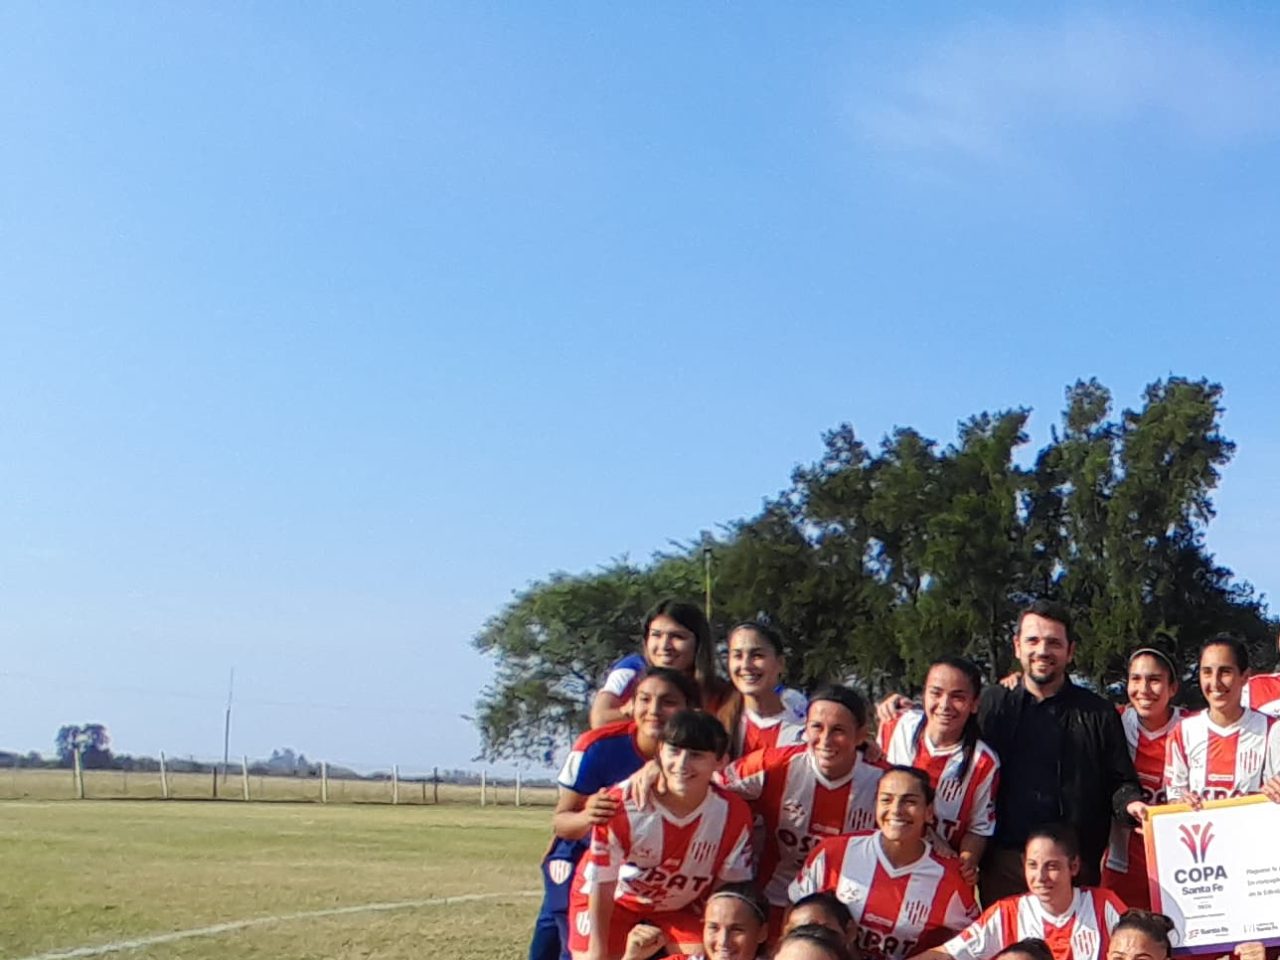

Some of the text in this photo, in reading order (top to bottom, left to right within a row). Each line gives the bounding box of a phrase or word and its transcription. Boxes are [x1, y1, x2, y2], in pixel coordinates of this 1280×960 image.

[1173, 864, 1229, 885] COPA
[1181, 882, 1225, 896] Santa Fe
